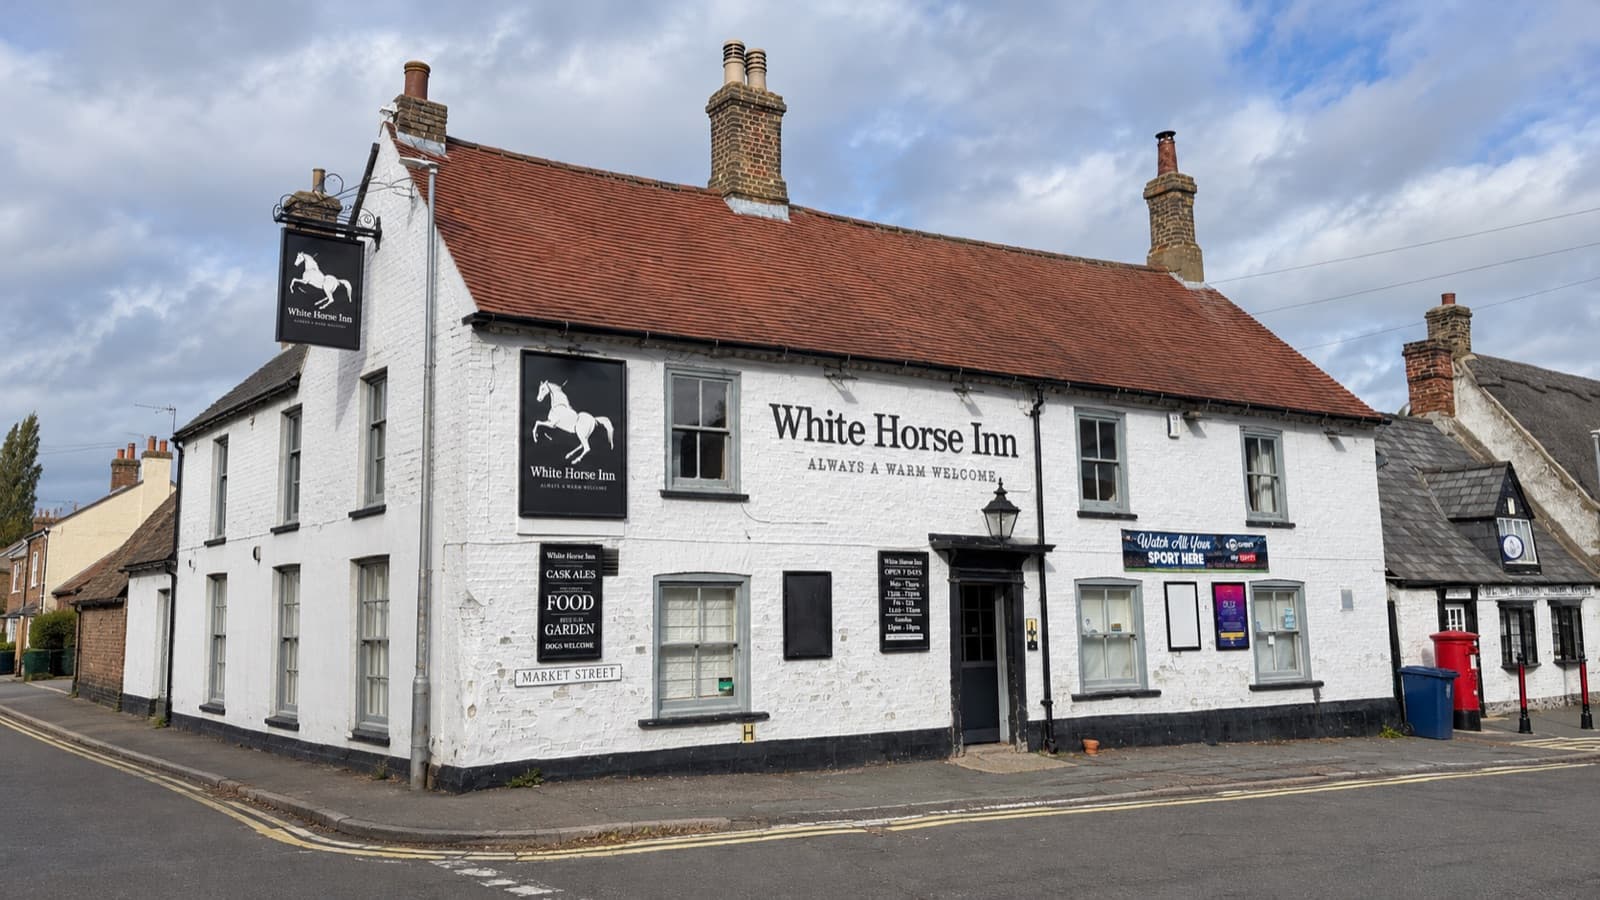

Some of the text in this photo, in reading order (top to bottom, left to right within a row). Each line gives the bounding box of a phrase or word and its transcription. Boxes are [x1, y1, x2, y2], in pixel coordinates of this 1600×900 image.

[288, 307, 312, 318] White
[338, 313, 352, 323] Inn
[768, 403, 1019, 458] White Horse Inn
[530, 466, 616, 480] White Horse Inn
[808, 458, 996, 483] ALWAYS A WARM WELCOME
[1137, 532, 1169, 549] Watch
[1171, 535, 1189, 549] All
[1148, 551, 1180, 564] SPORT
[1181, 552, 1205, 565] HERE
[546, 570, 596, 579] CASK ALES
[546, 594, 594, 610] FOOD
[545, 623, 595, 636] GARDEN
[522, 667, 616, 682] MARKET STREET
[744, 725, 753, 741] H
